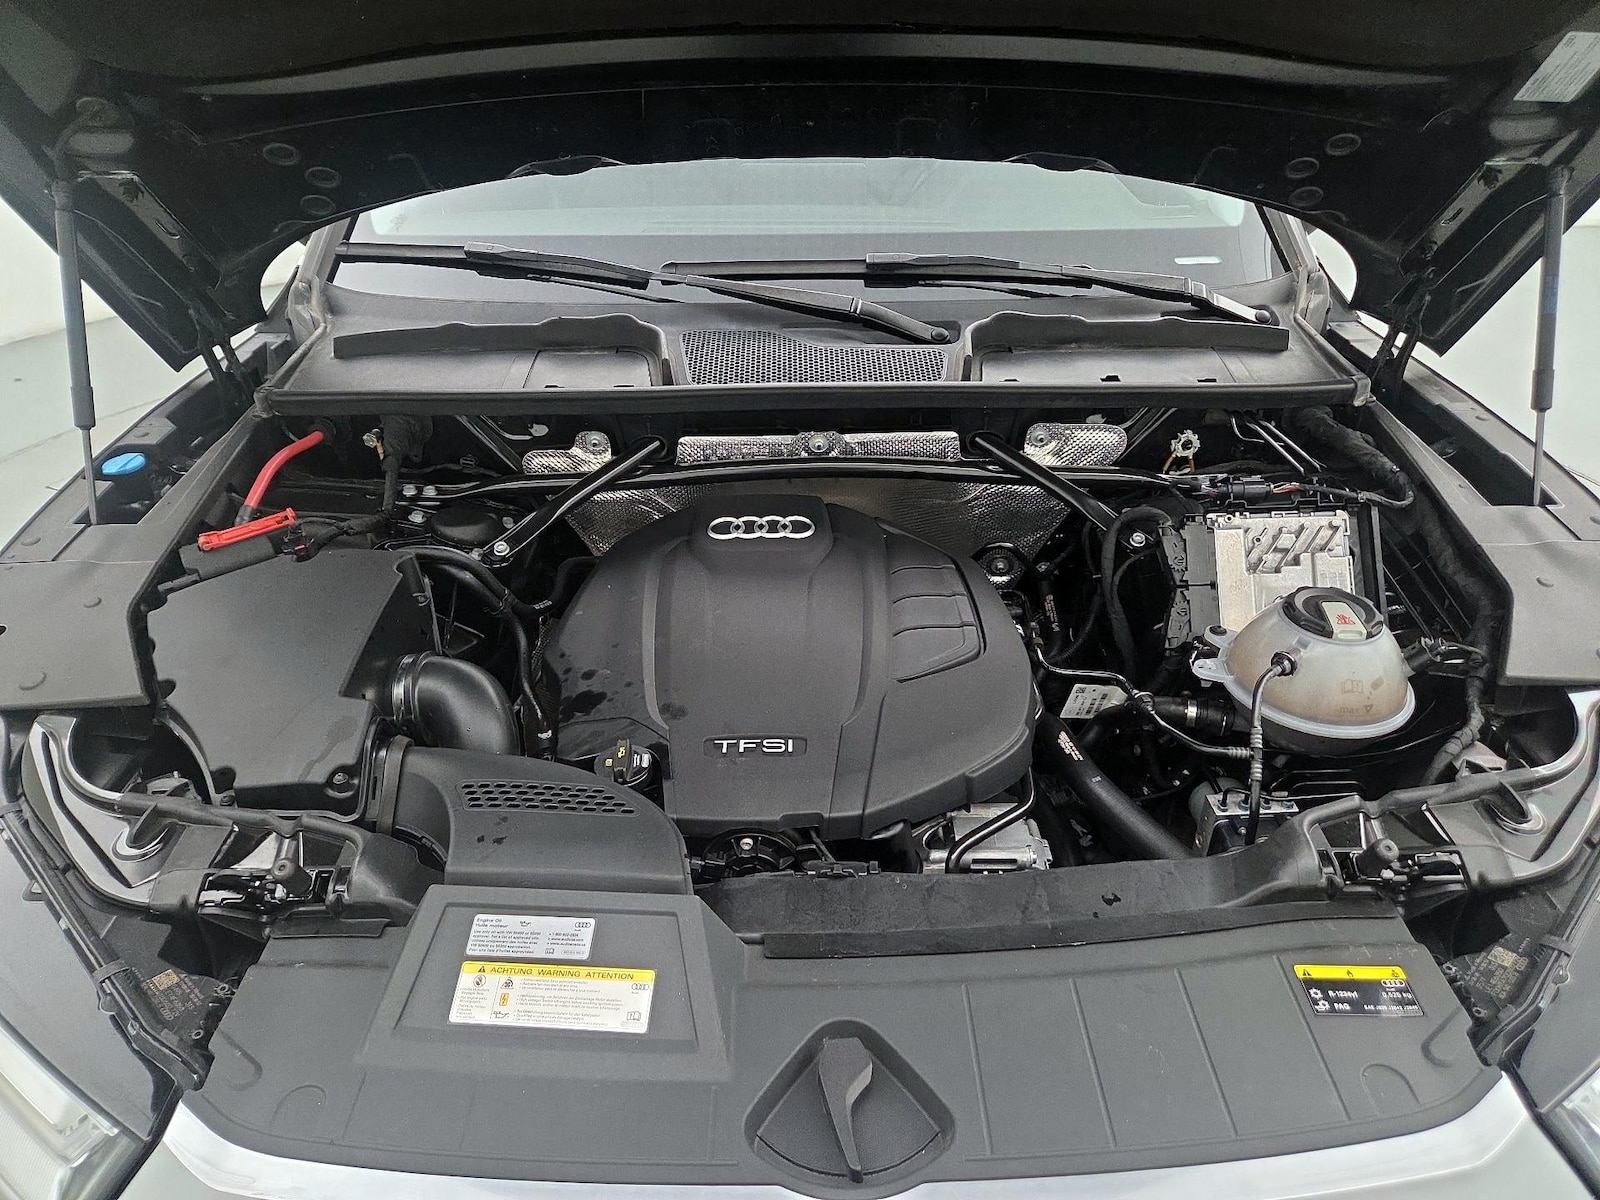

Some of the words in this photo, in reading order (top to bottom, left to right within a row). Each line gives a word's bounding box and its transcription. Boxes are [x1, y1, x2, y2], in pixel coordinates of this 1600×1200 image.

[713, 739, 793, 753] TFSI
[490, 966, 533, 975] ACHTUNG
[537, 968, 580, 978] WARNING
[585, 971, 634, 980] ATTENTION
[1333, 1002, 1350, 1010] PAG
